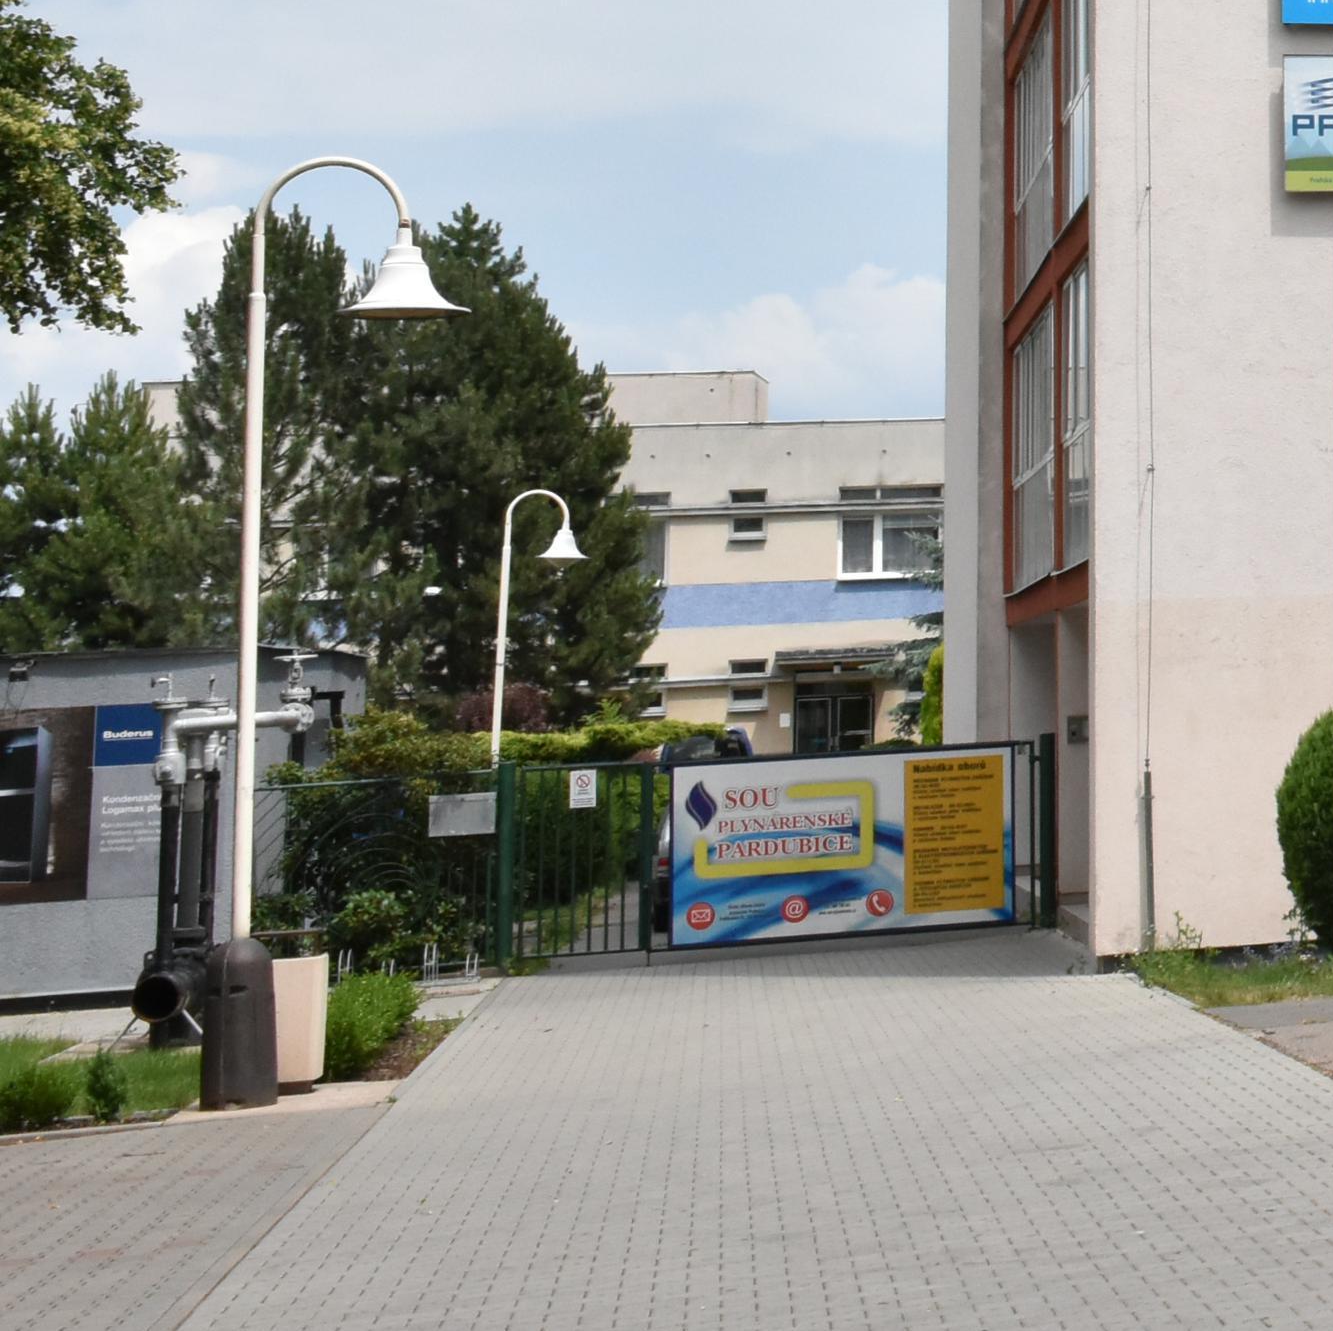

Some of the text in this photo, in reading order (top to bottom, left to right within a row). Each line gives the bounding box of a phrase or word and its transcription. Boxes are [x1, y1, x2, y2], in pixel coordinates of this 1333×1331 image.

[102, 729, 154, 739] Buderus
[724, 787, 779, 809] SOU
[718, 807, 853, 833] PLYNÁRENSKÉ
[717, 835, 852, 859] PARDUBICE
